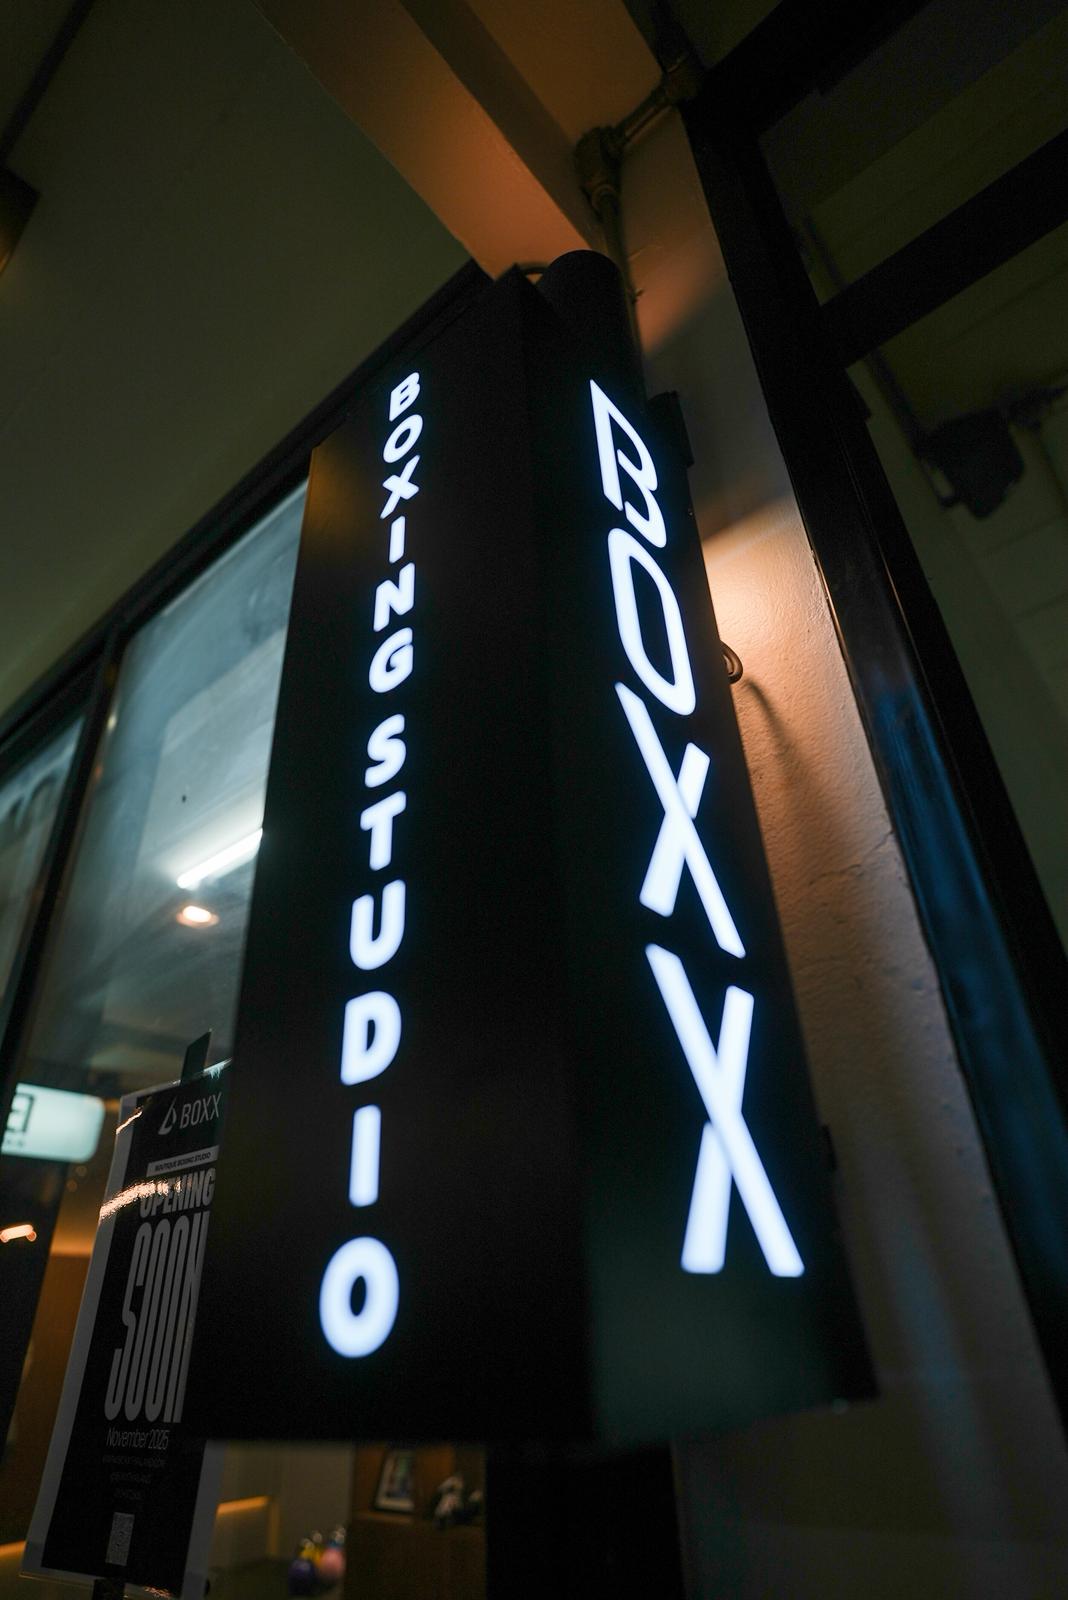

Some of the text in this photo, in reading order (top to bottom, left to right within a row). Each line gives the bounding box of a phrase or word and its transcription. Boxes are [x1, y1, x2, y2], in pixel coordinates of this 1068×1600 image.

[319, 372, 423, 1358] BOXING STUDIO
[589, 379, 804, 1277] BOXX
[180, 1093, 222, 1129] BOXX
[104, 1211, 210, 1423] SOON
[106, 1427, 149, 1448] November
